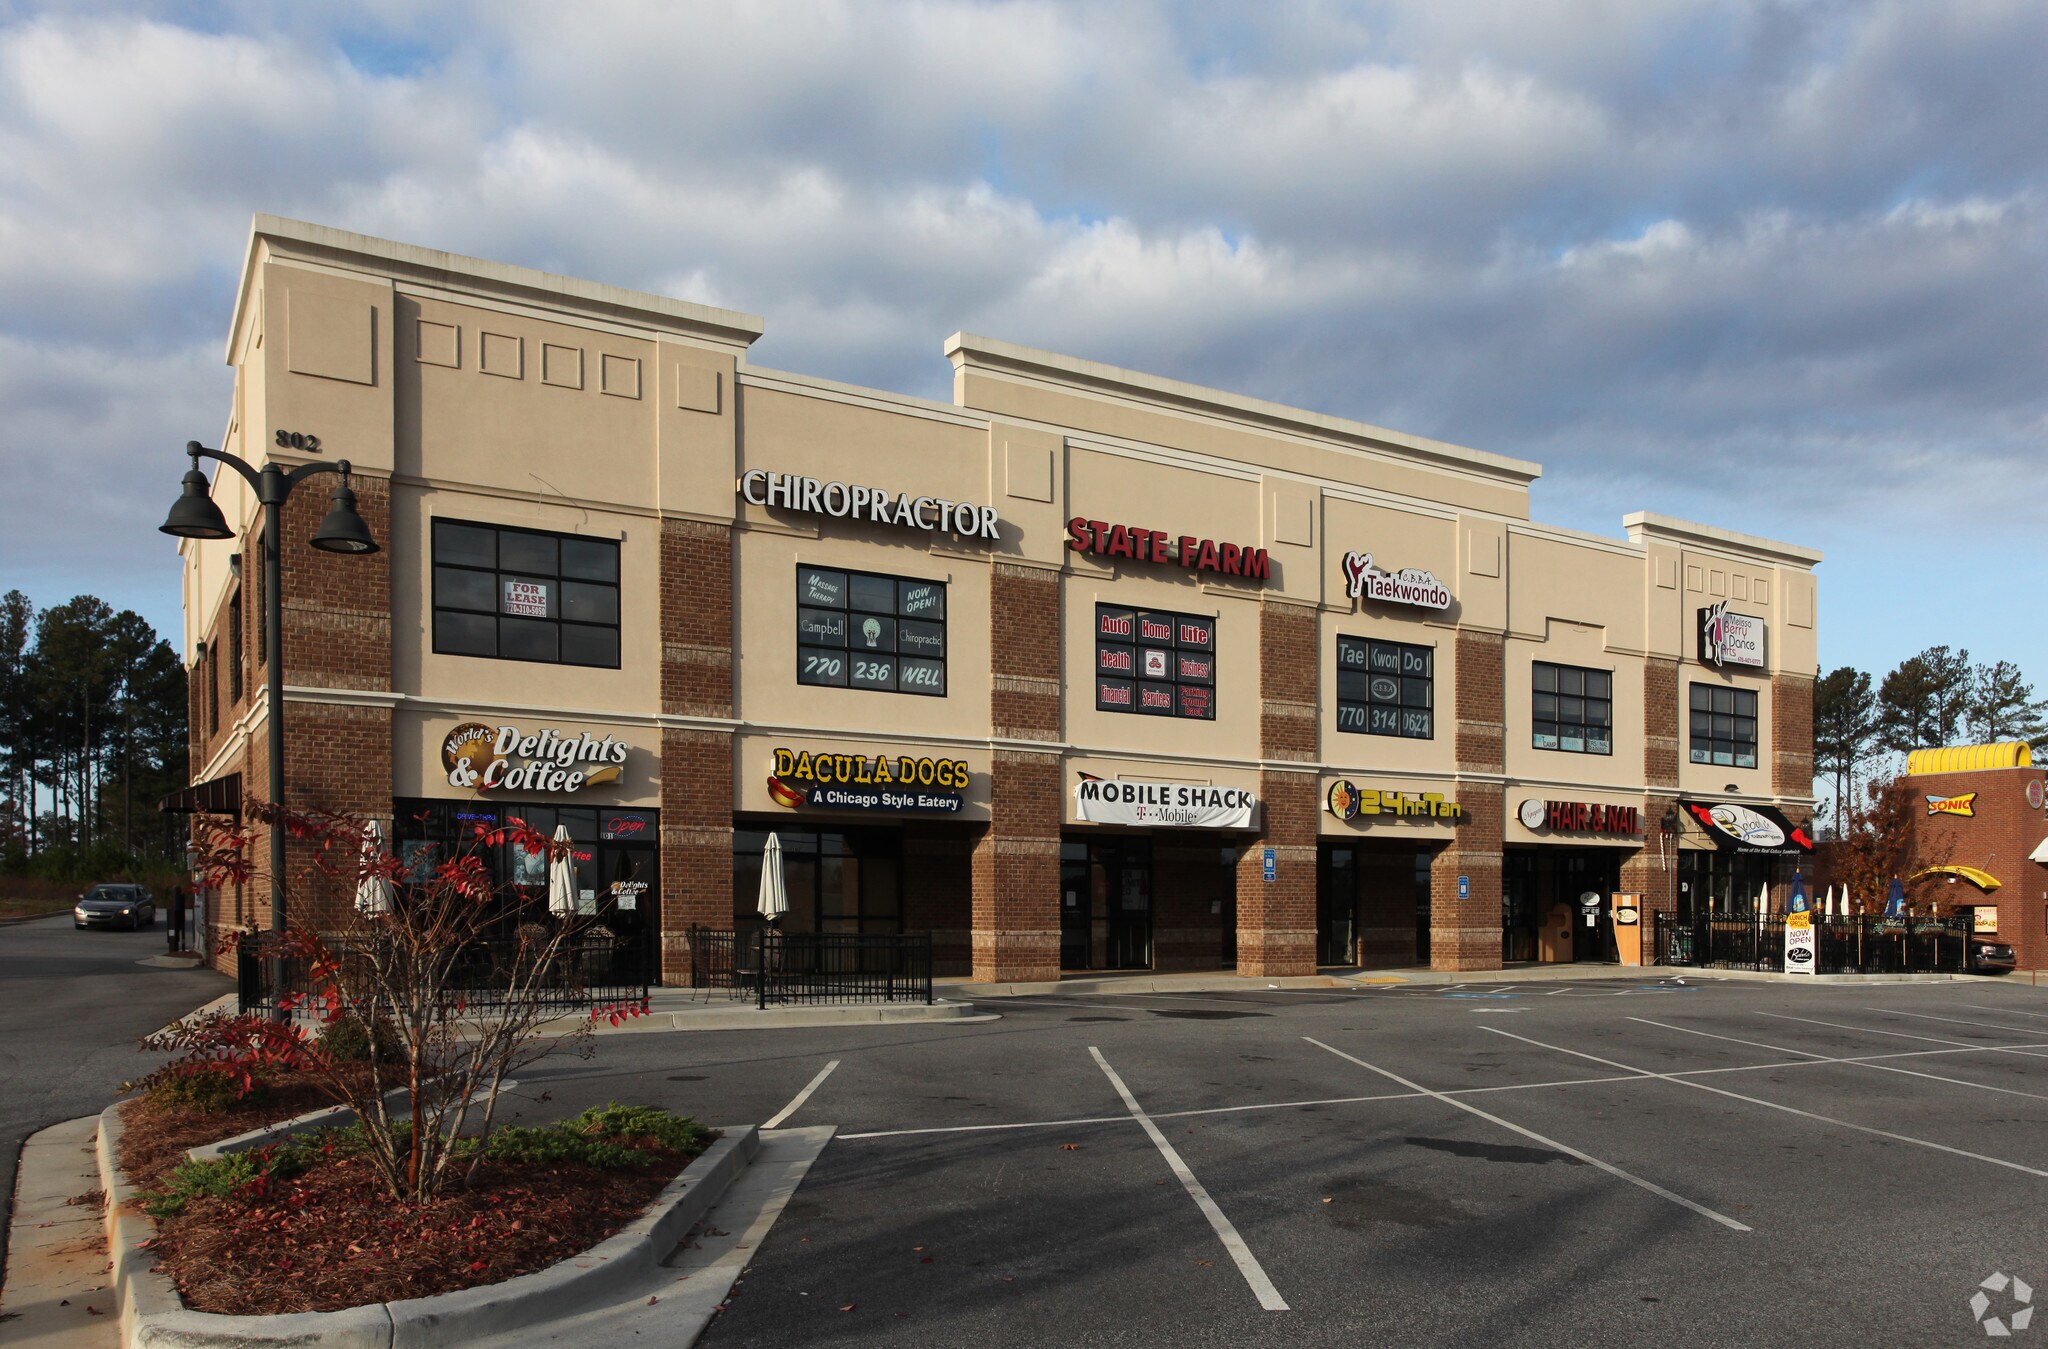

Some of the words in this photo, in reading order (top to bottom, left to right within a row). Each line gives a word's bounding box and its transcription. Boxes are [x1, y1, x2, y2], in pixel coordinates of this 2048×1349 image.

[276, 429, 322, 454] 802
[742, 469, 1000, 540] CHIROPRACTOR
[1068, 517, 1168, 564] STATE
[1178, 535, 1270, 580] FARM
[507, 592, 546, 605] LEASE
[513, 583, 539, 594] FOR
[907, 587, 931, 601] NOW
[1367, 574, 1448, 606] Taekwondo
[906, 597, 936, 613] OPEN!
[801, 618, 844, 641] Campbell
[900, 629, 942, 649] Chiropractic
[1101, 614, 1130, 635] Auto
[1142, 620, 1170, 639] Home
[1181, 625, 1208, 644] Life
[1724, 620, 1747, 639] Berry
[1721, 643, 1736, 657] Arts
[1729, 635, 1755, 650] Dance
[1101, 650, 1130, 669] Health
[1181, 658, 1208, 678] Business
[1339, 644, 1365, 664] Tae
[1371, 648, 1398, 669] Kwon
[1404, 652, 1423, 671] Do
[804, 656, 841, 676] 770
[854, 661, 891, 681] 236
[901, 666, 940, 686] WELL
[1101, 685, 1130, 704] Financial
[1142, 689, 1170, 708] Services
[1180, 686, 1209, 699] Parking
[1185, 706, 1204, 717] Back
[1339, 707, 1365, 726] 770
[1371, 710, 1397, 730] 314
[445, 728, 494, 755] World's
[493, 726, 628, 768] Delights
[449, 756, 479, 787] &
[483, 759, 584, 793] Coffee
[775, 748, 893, 784] DACULA
[899, 756, 969, 789] DOGS
[813, 791, 823, 803] A
[827, 791, 878, 808] Chicago
[882, 793, 915, 809] Style
[918, 795, 959, 811] Eatery
[1080, 782, 1170, 804] MOBILE
[1178, 787, 1251, 809] SHACK
[1930, 800, 1972, 811] SONIC
[456, 812, 497, 821] DRVE-THRU
[607, 817, 647, 835] Open
[1547, 801, 1588, 831] HAIR
[1592, 804, 1604, 832] &
[1606, 805, 1642, 835] NAIL
[1789, 914, 1808, 922] LUNCH
[1789, 929, 1809, 938] NOW
[1789, 936, 1811, 945] OPEN
